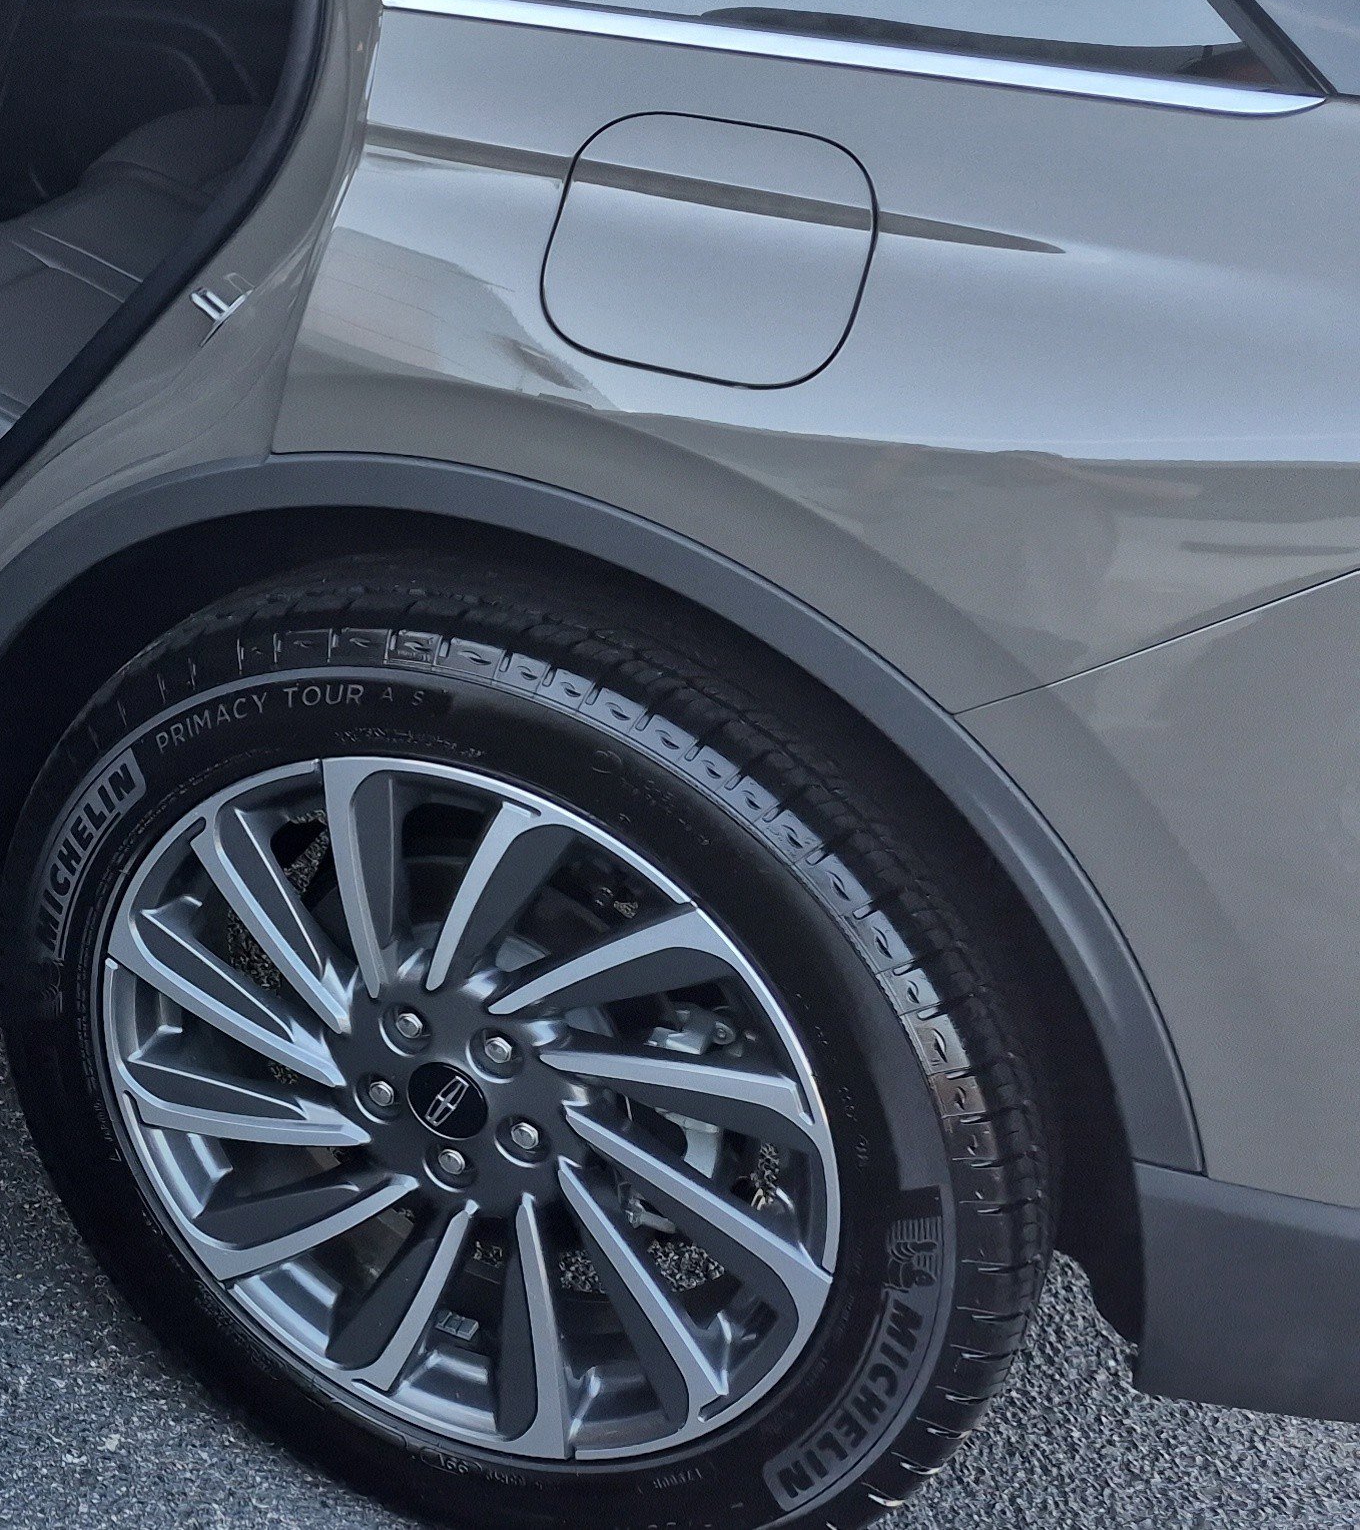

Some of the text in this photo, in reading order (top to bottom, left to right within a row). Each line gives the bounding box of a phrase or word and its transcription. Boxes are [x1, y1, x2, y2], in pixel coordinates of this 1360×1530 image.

[155, 691, 268, 754] PRIMACY
[283, 683, 365, 709] TOUR
[38, 762, 136, 953] MICHELIN
[776, 1298, 924, 1499] MICHELIN
